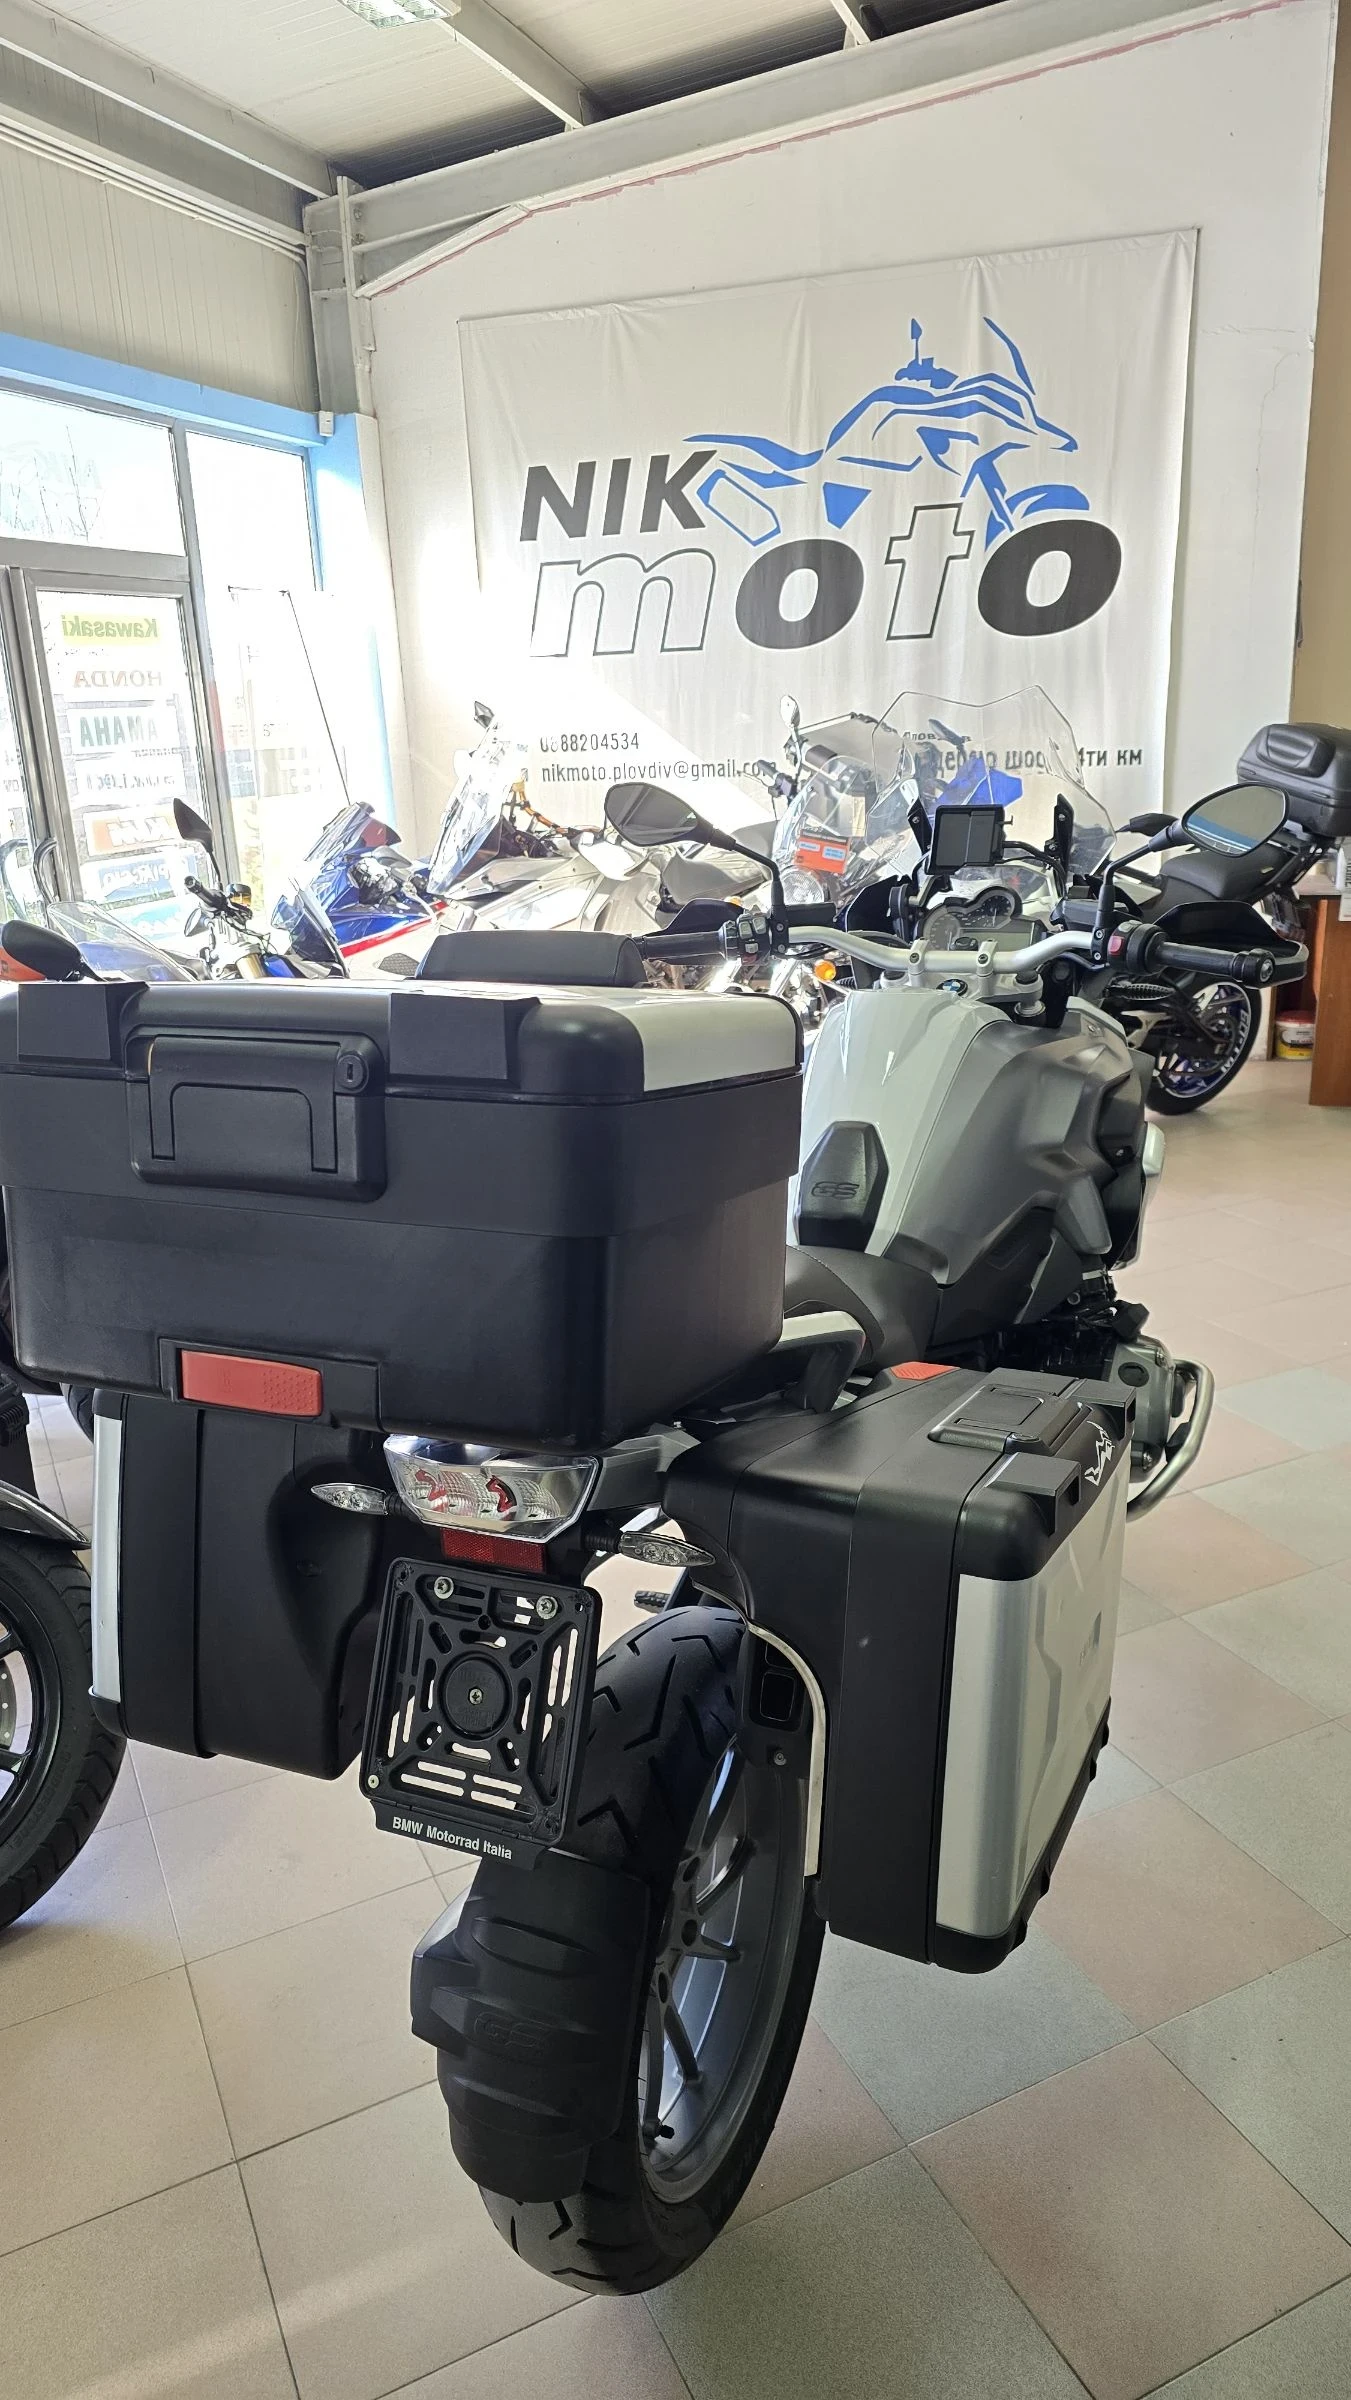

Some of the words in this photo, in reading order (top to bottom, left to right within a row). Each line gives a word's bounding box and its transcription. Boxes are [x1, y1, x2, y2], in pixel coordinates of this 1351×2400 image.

[520, 449, 717, 542] NIK
[529, 502, 1122, 657] moto
[1117, 749, 1142, 766] км
[811, 1181, 860, 1200] GS
[392, 1816, 424, 1835] BMW
[426, 1825, 480, 1851] Motorrad
[483, 1840, 512, 1860] Italia
